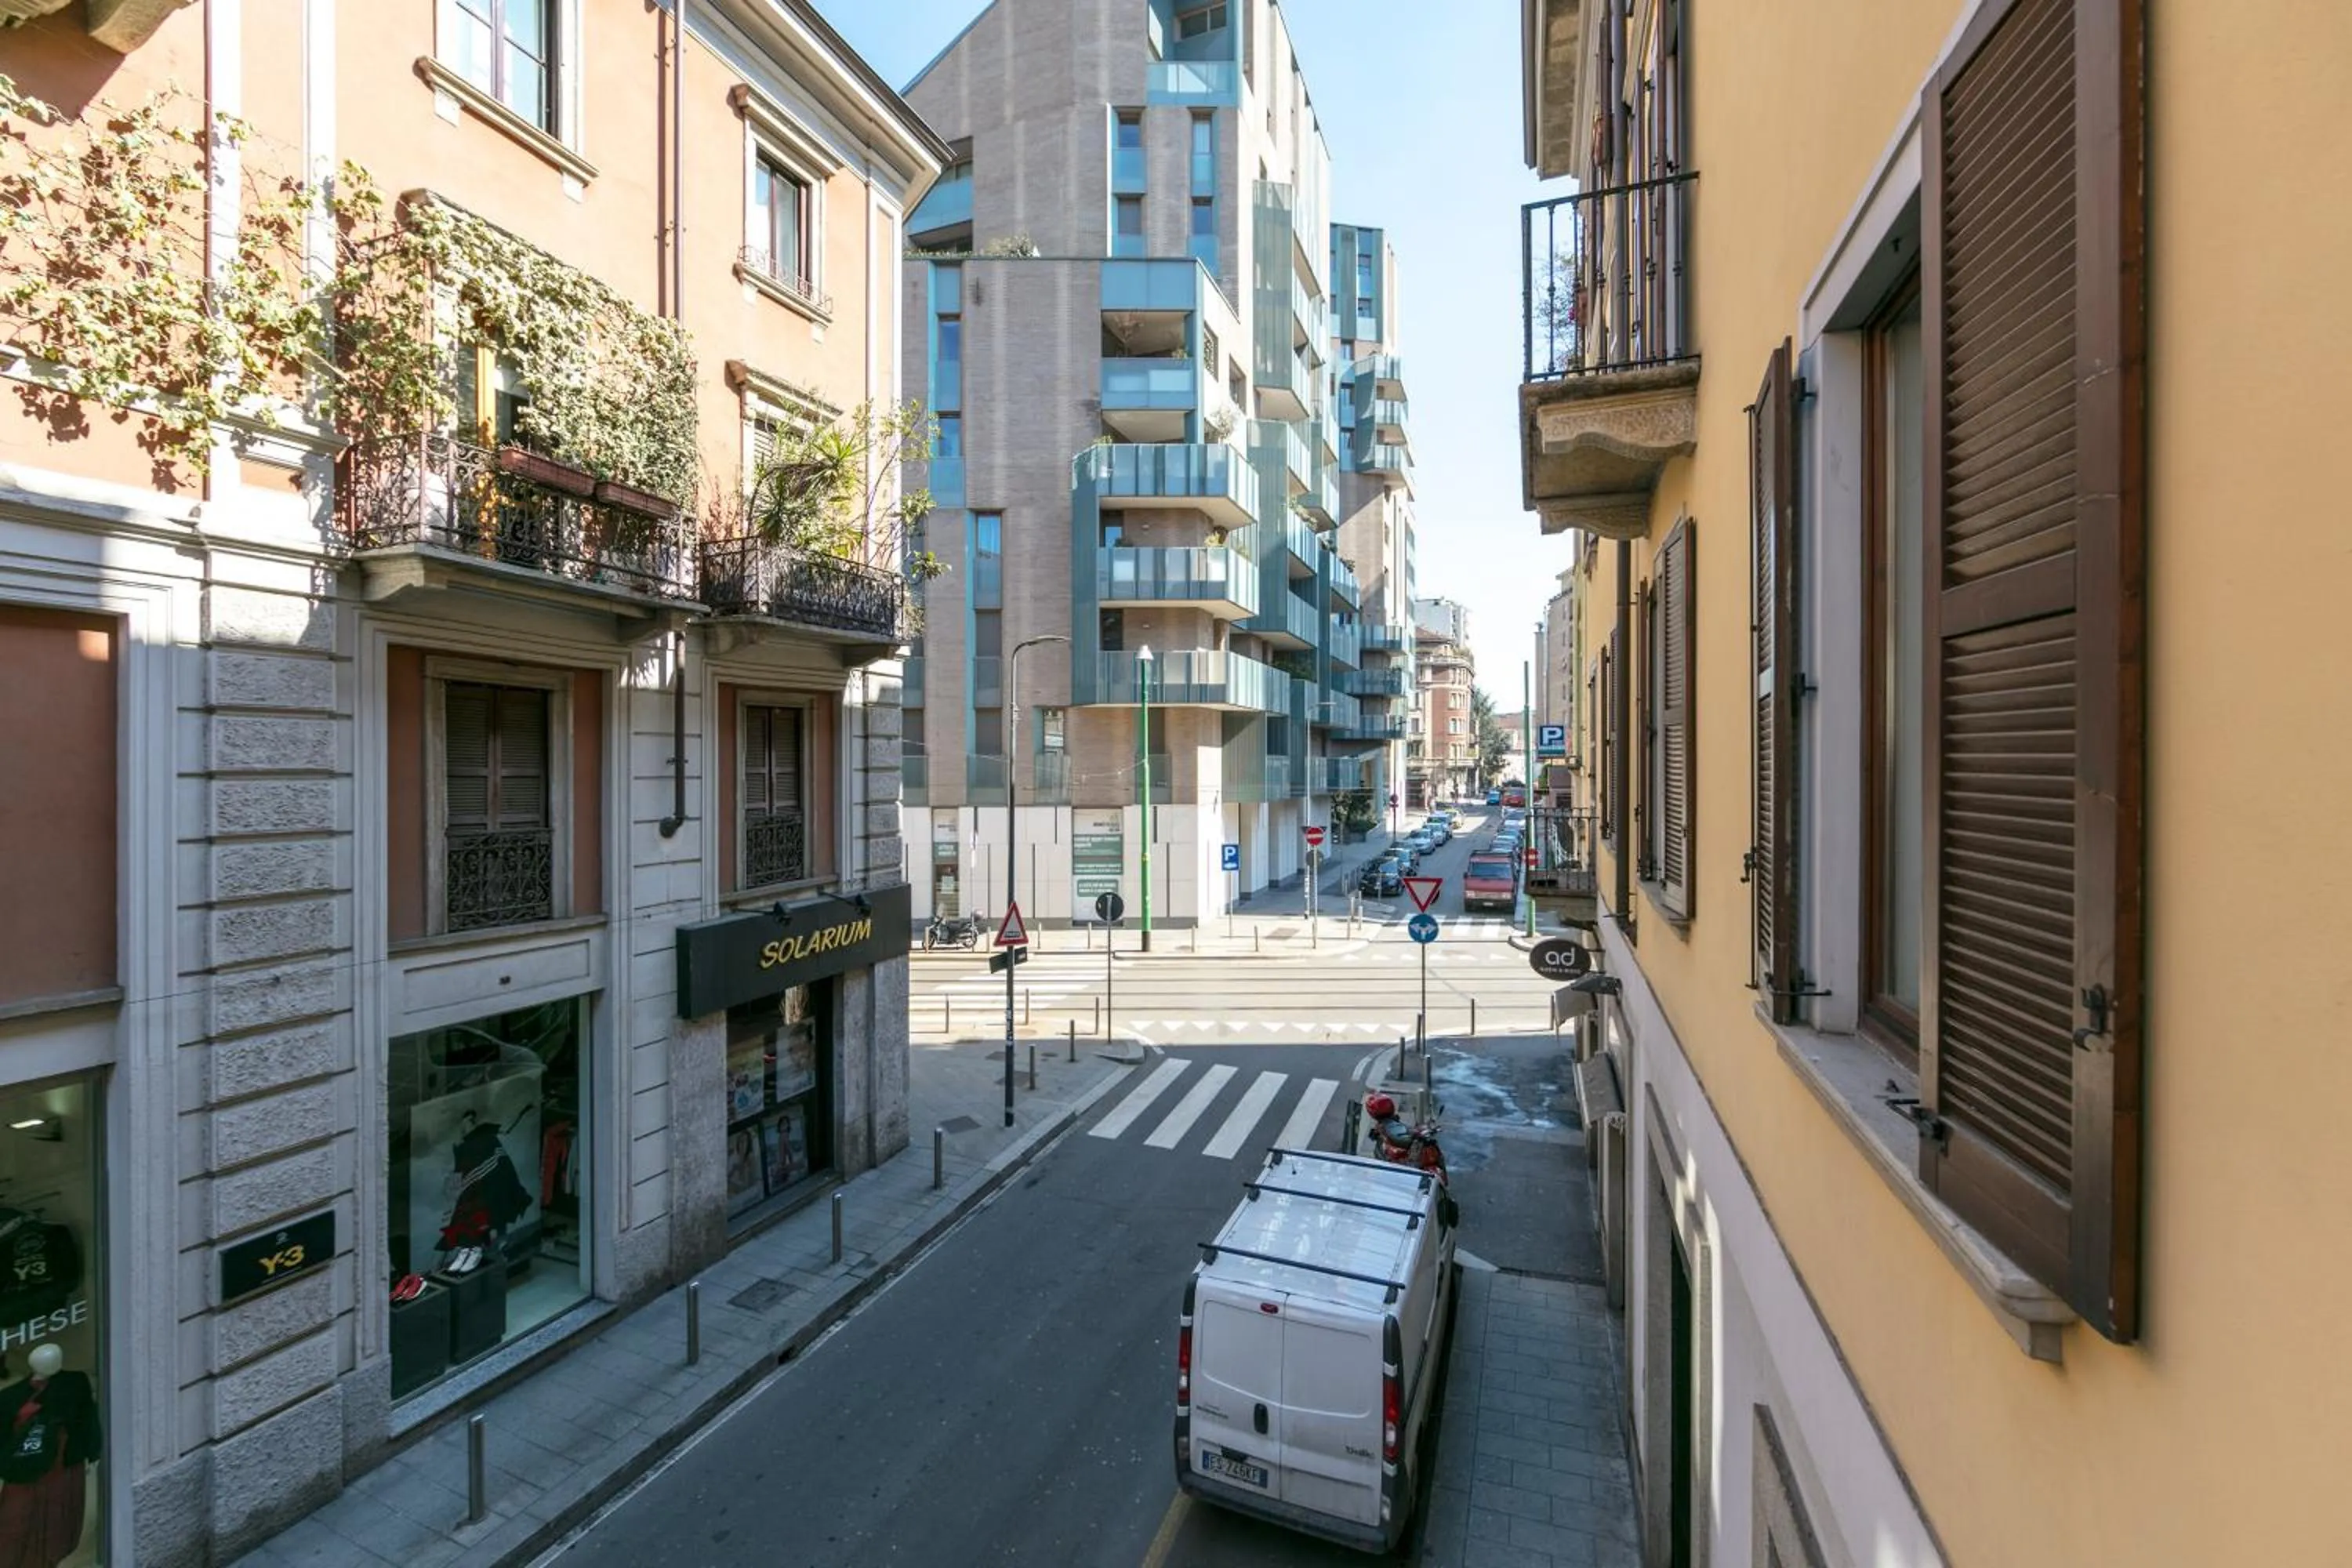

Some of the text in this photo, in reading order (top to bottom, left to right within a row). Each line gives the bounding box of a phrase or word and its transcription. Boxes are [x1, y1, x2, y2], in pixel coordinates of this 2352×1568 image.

[1542, 728, 1563, 744] P
[1225, 846, 1236, 861] P
[759, 917, 872, 969] SOLARIUM
[1545, 946, 1575, 967] ad
[1, 1298, 89, 1351] HESE
